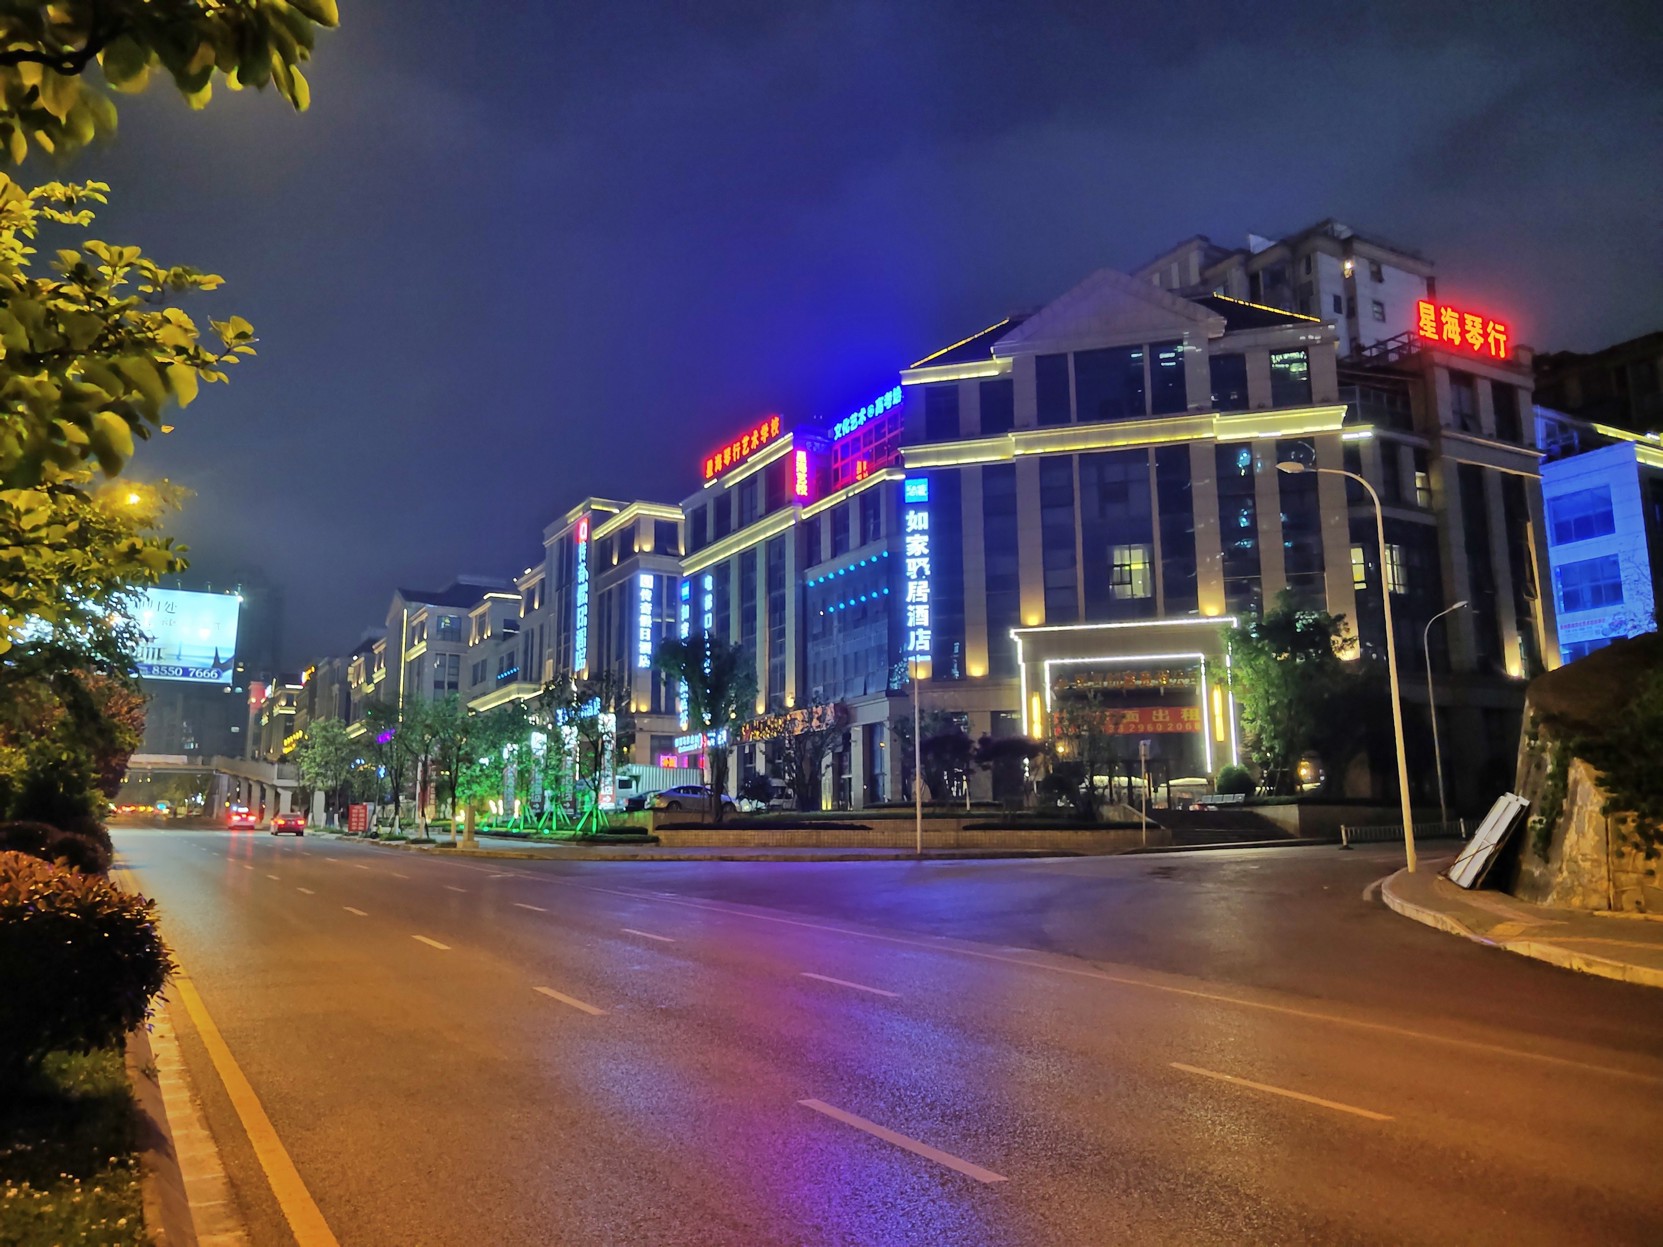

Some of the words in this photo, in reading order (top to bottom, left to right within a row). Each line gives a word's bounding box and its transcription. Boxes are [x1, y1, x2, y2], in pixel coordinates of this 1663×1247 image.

[1419, 300, 1507, 359] 星海琴行
[705, 416, 780, 479] 星海琴行艺术学校
[905, 510, 931, 651] 如家驿居酒店
[152, 664, 183, 677] 8550
[188, 667, 219, 680] 7666
